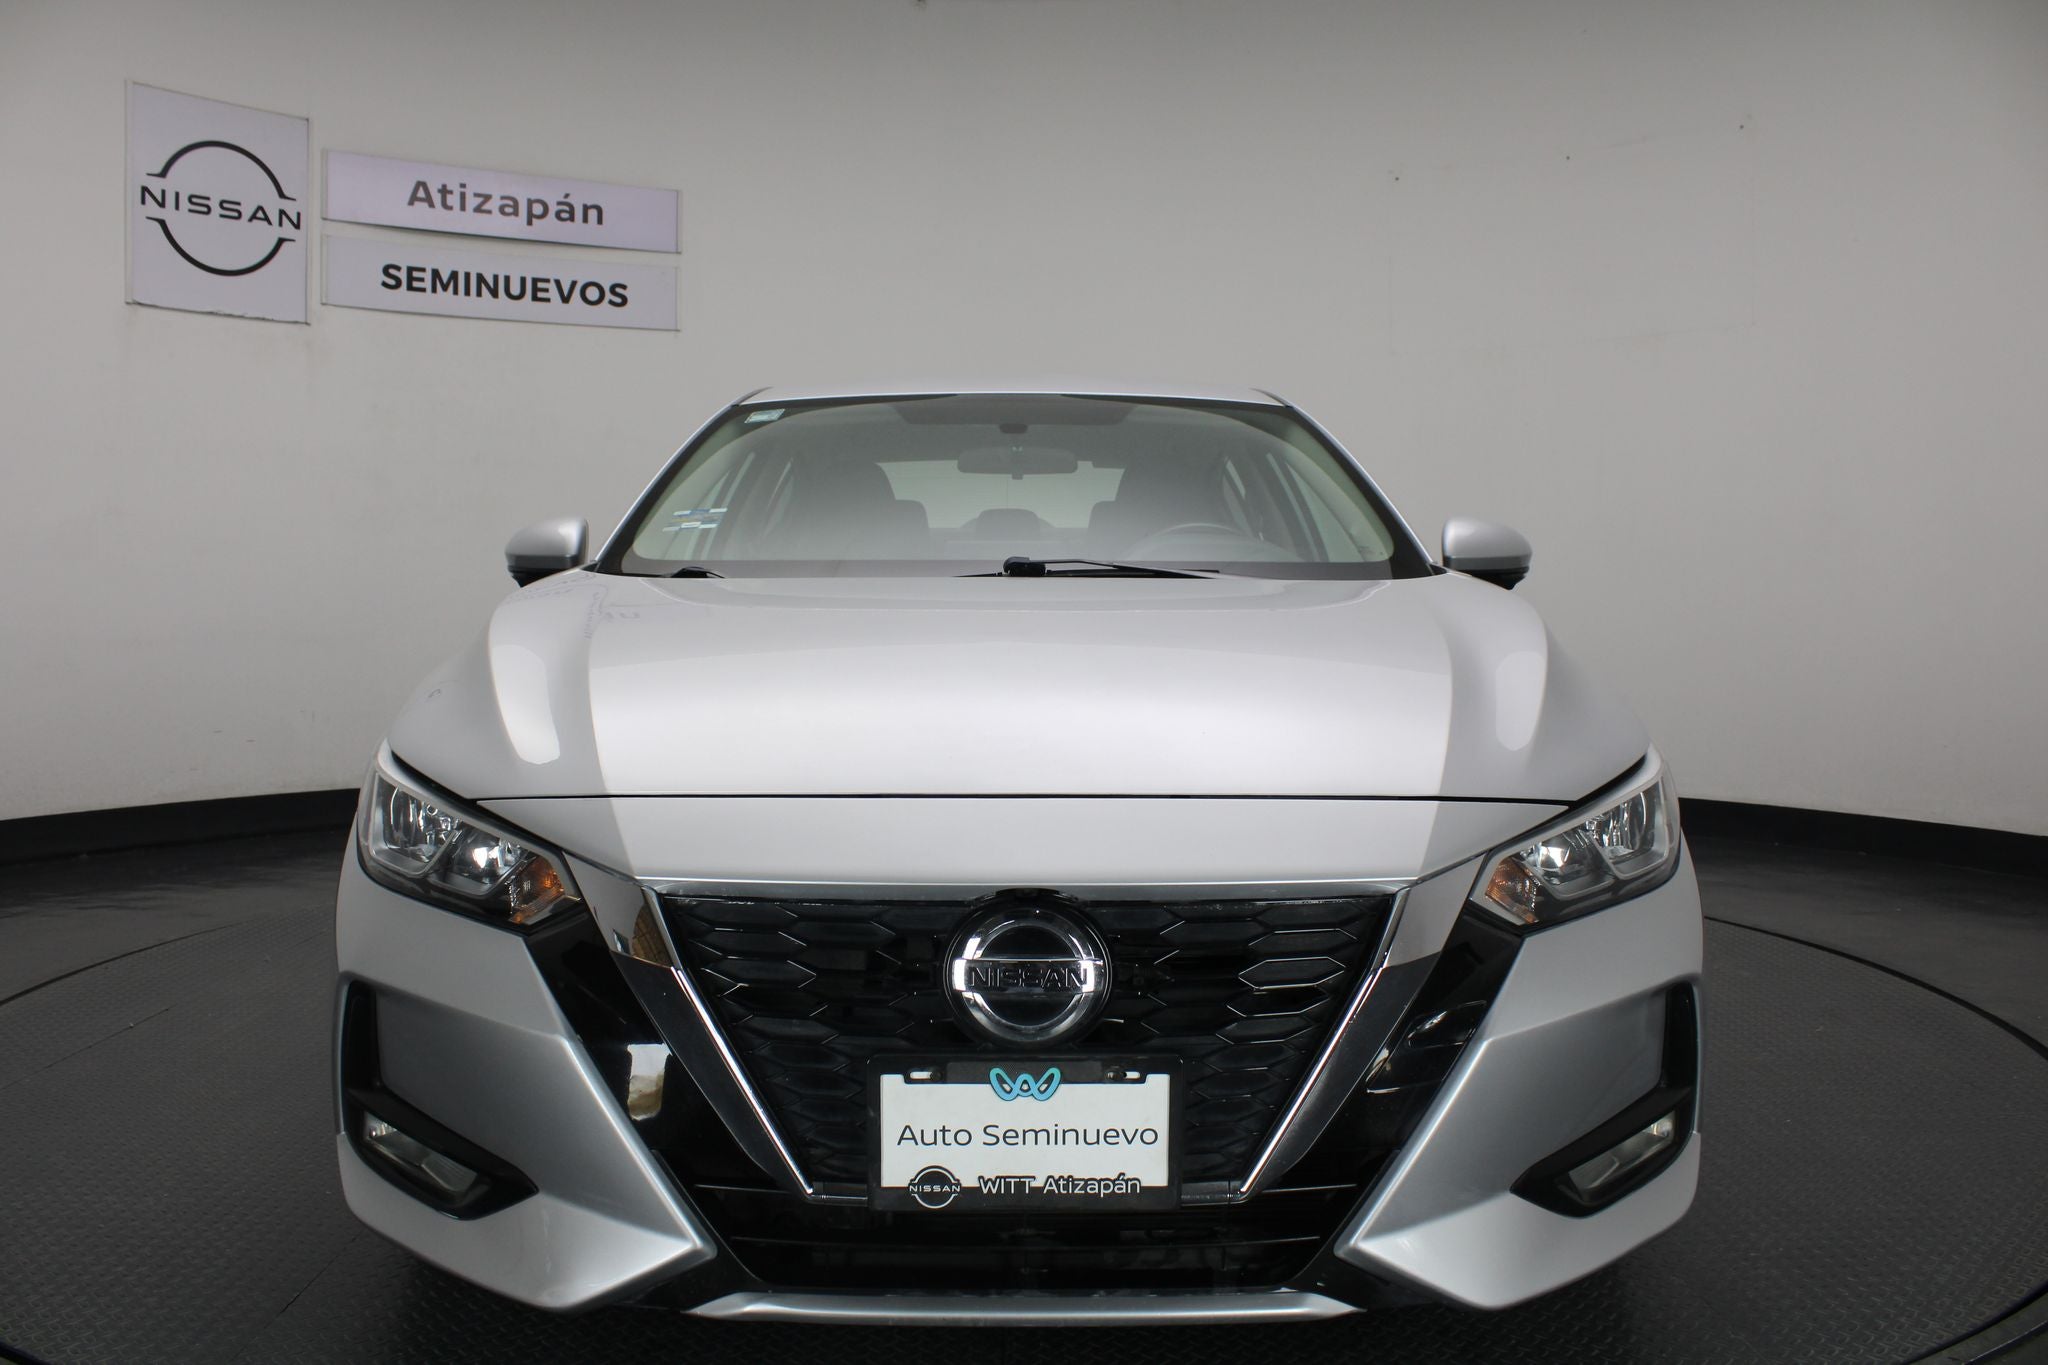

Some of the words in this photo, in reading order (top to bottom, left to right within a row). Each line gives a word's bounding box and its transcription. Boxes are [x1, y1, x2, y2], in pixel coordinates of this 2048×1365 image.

[140, 185, 302, 231] NISSAN
[407, 180, 605, 226] Atizapán
[380, 264, 629, 308] SEMINUEVOS
[968, 965, 1089, 988] NISSAN
[897, 1124, 973, 1147] Auto
[982, 1123, 1159, 1147] Seminuevo
[908, 1183, 961, 1193] NISSAN
[979, 1176, 1035, 1196] WITT
[1043, 1173, 1142, 1198] Atizapán
